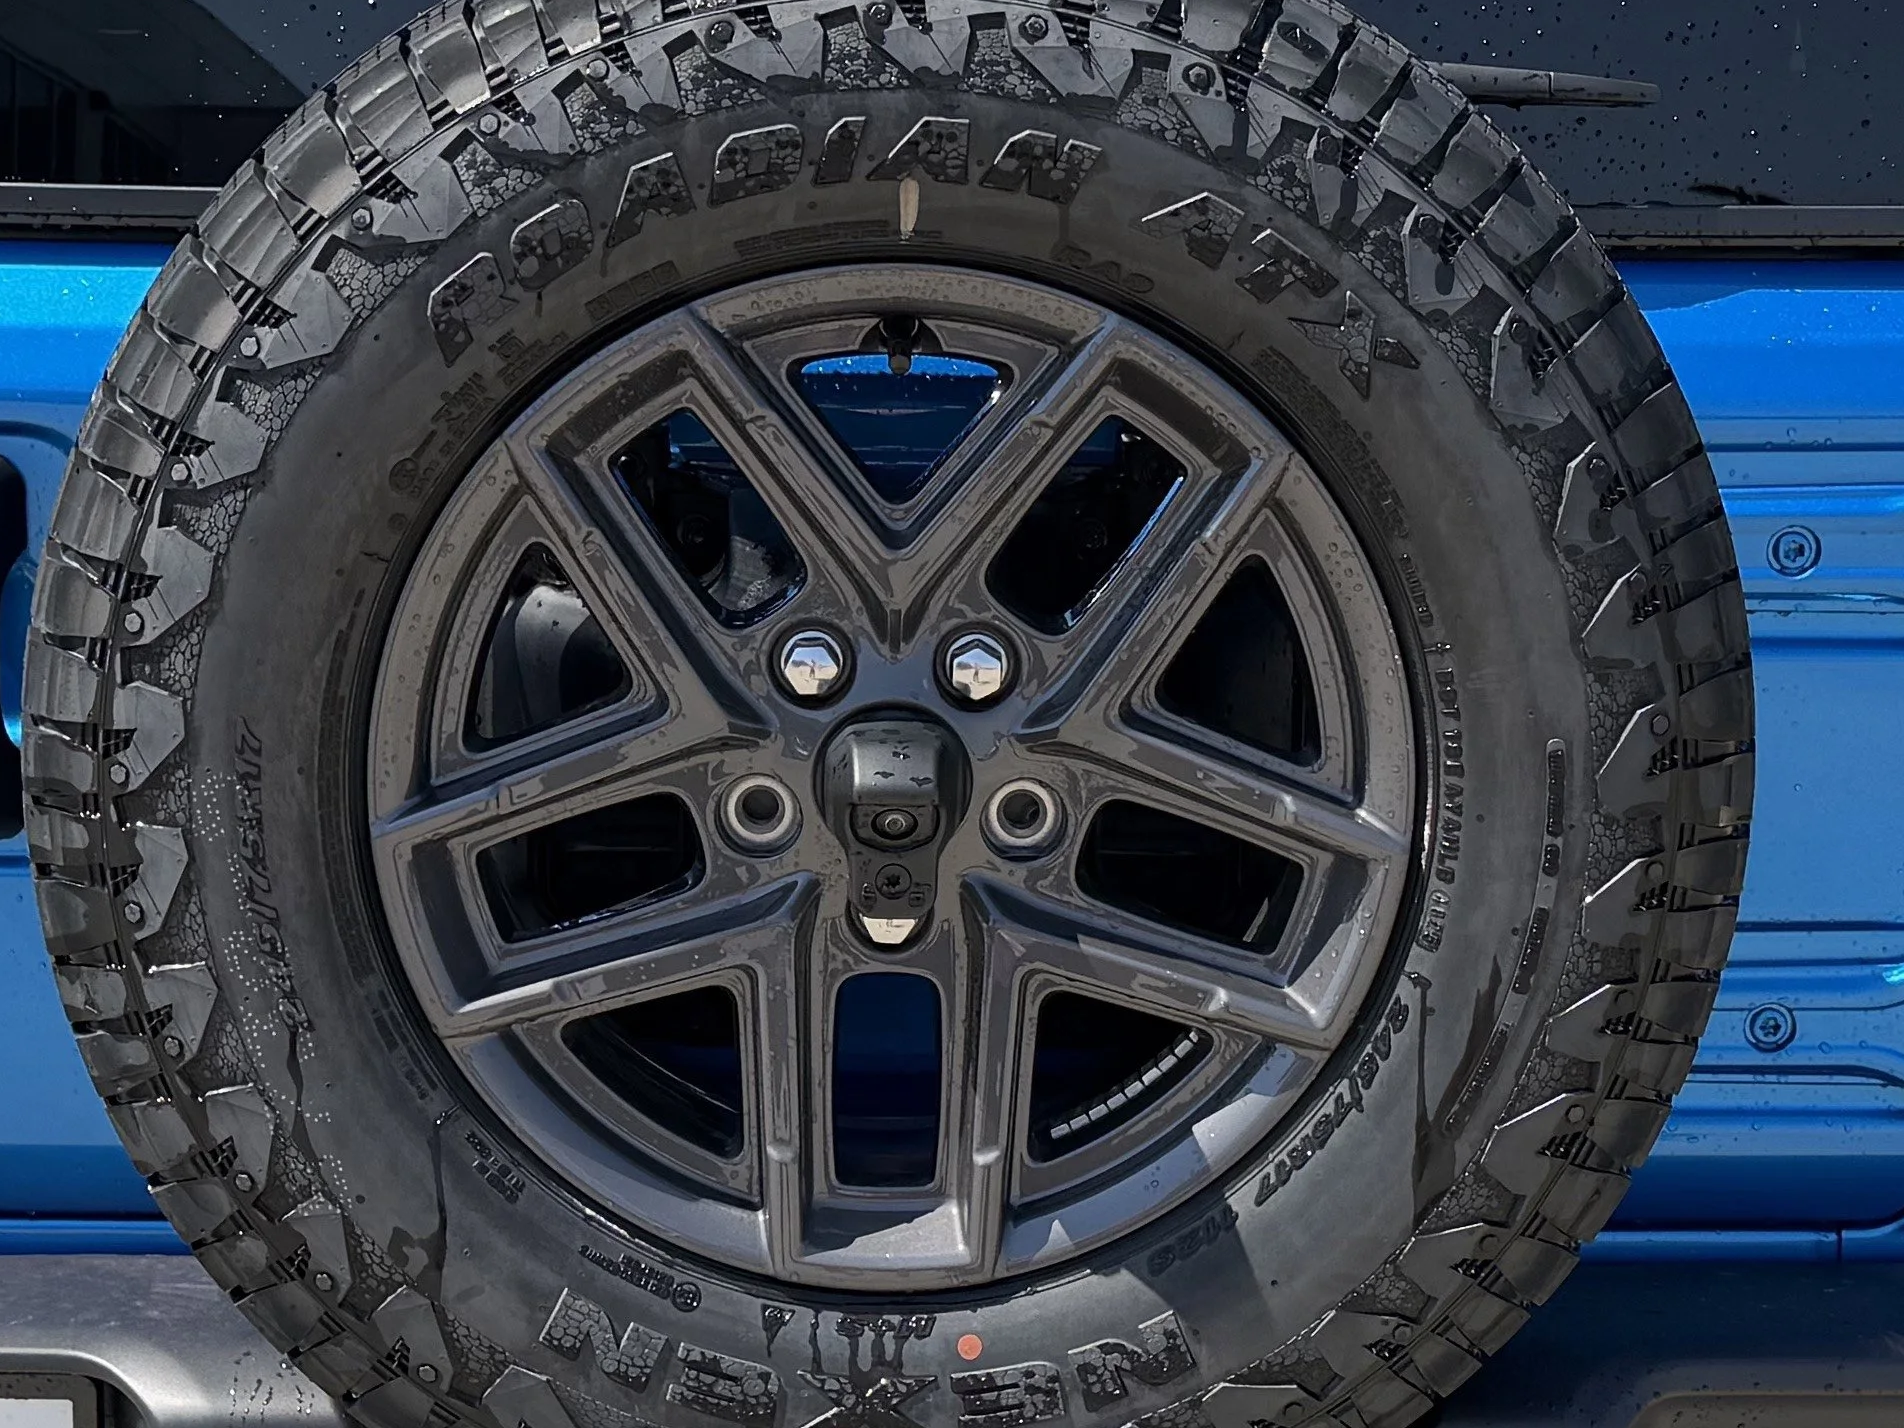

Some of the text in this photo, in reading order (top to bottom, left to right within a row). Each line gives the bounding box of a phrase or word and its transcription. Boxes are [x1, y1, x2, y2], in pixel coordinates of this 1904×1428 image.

[427, 116, 1421, 401] ROADIAN ATX
[1253, 994, 1410, 1208] 245/75R17
